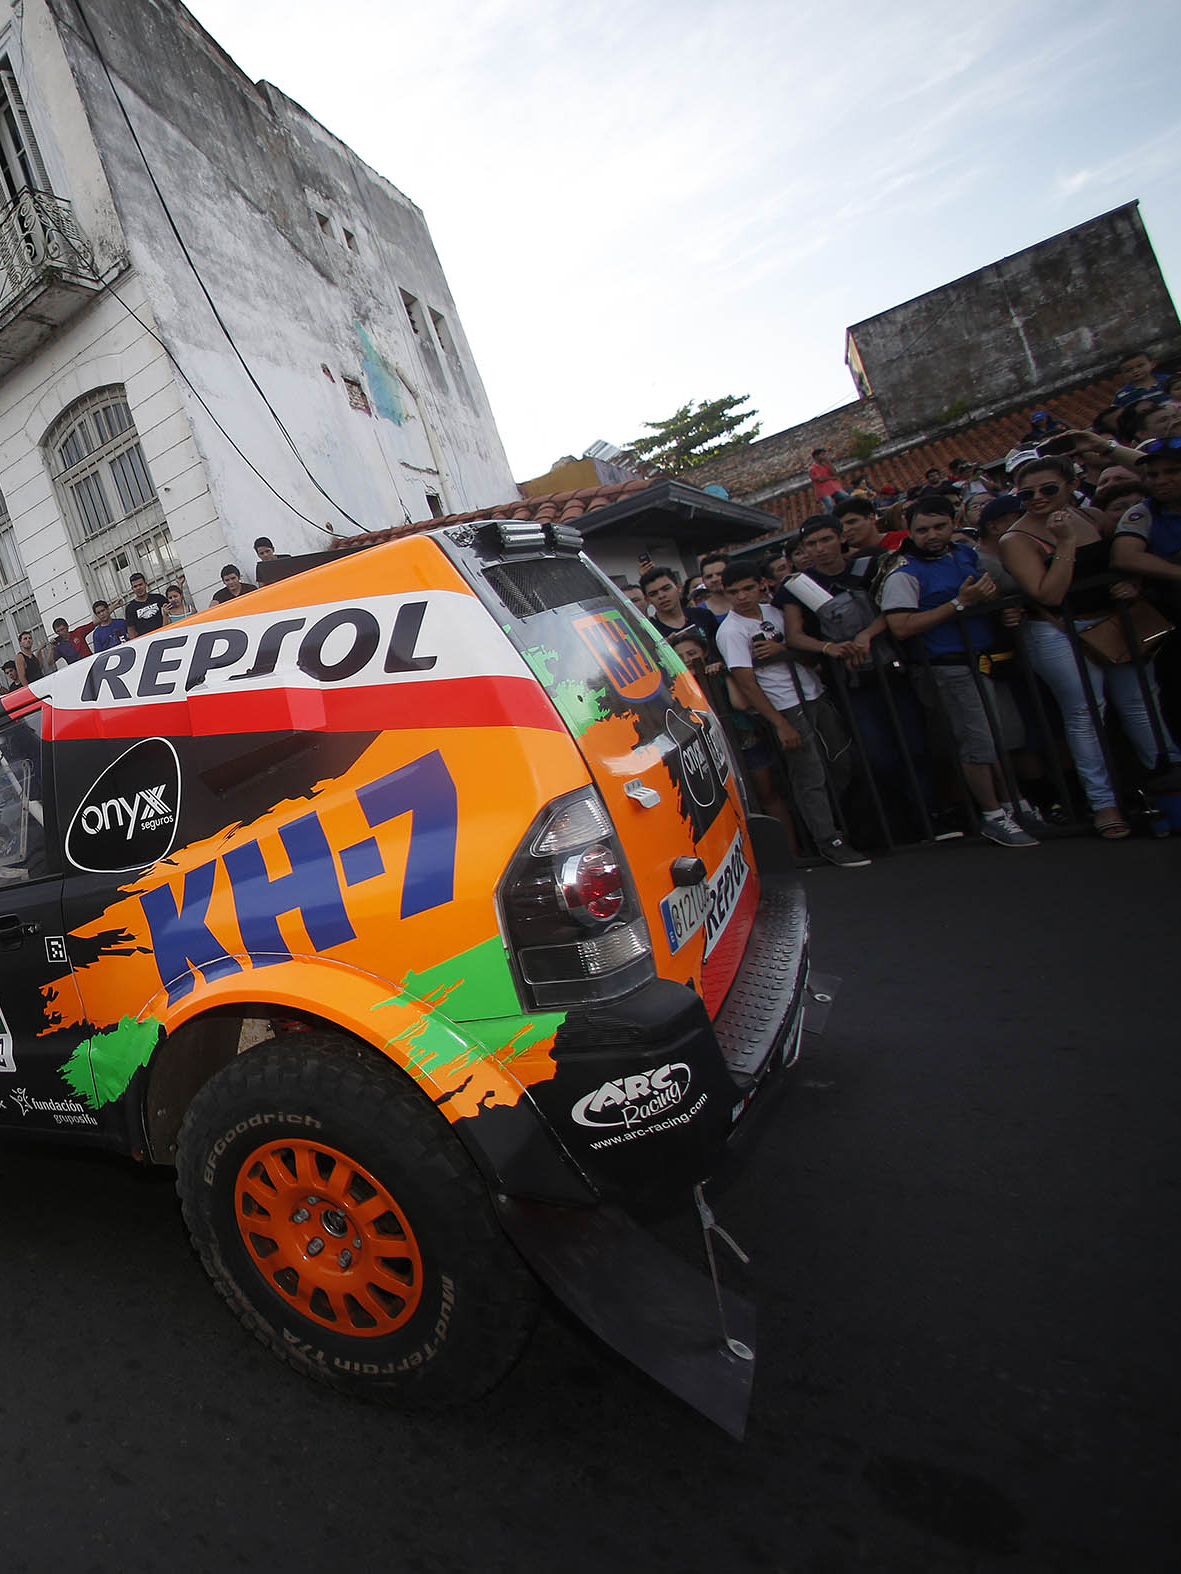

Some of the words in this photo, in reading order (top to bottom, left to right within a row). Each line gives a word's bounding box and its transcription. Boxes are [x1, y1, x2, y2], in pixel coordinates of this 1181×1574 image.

[80, 601, 438, 701] REPSOL
[81, 784, 172, 840] onyx
[141, 815, 174, 831] seguros
[139, 749, 457, 1006] KH-7
[31, 1098, 84, 1112] fundación
[589, 1064, 672, 1112] ARC
[621, 1081, 682, 1128] Racing
[53, 1114, 99, 1125] gruposifu
[590, 1093, 708, 1149] www.arc-racing.com
[204, 1112, 322, 1186] BFGoodrich
[334, 1274, 455, 1375] Mud-Terrain
